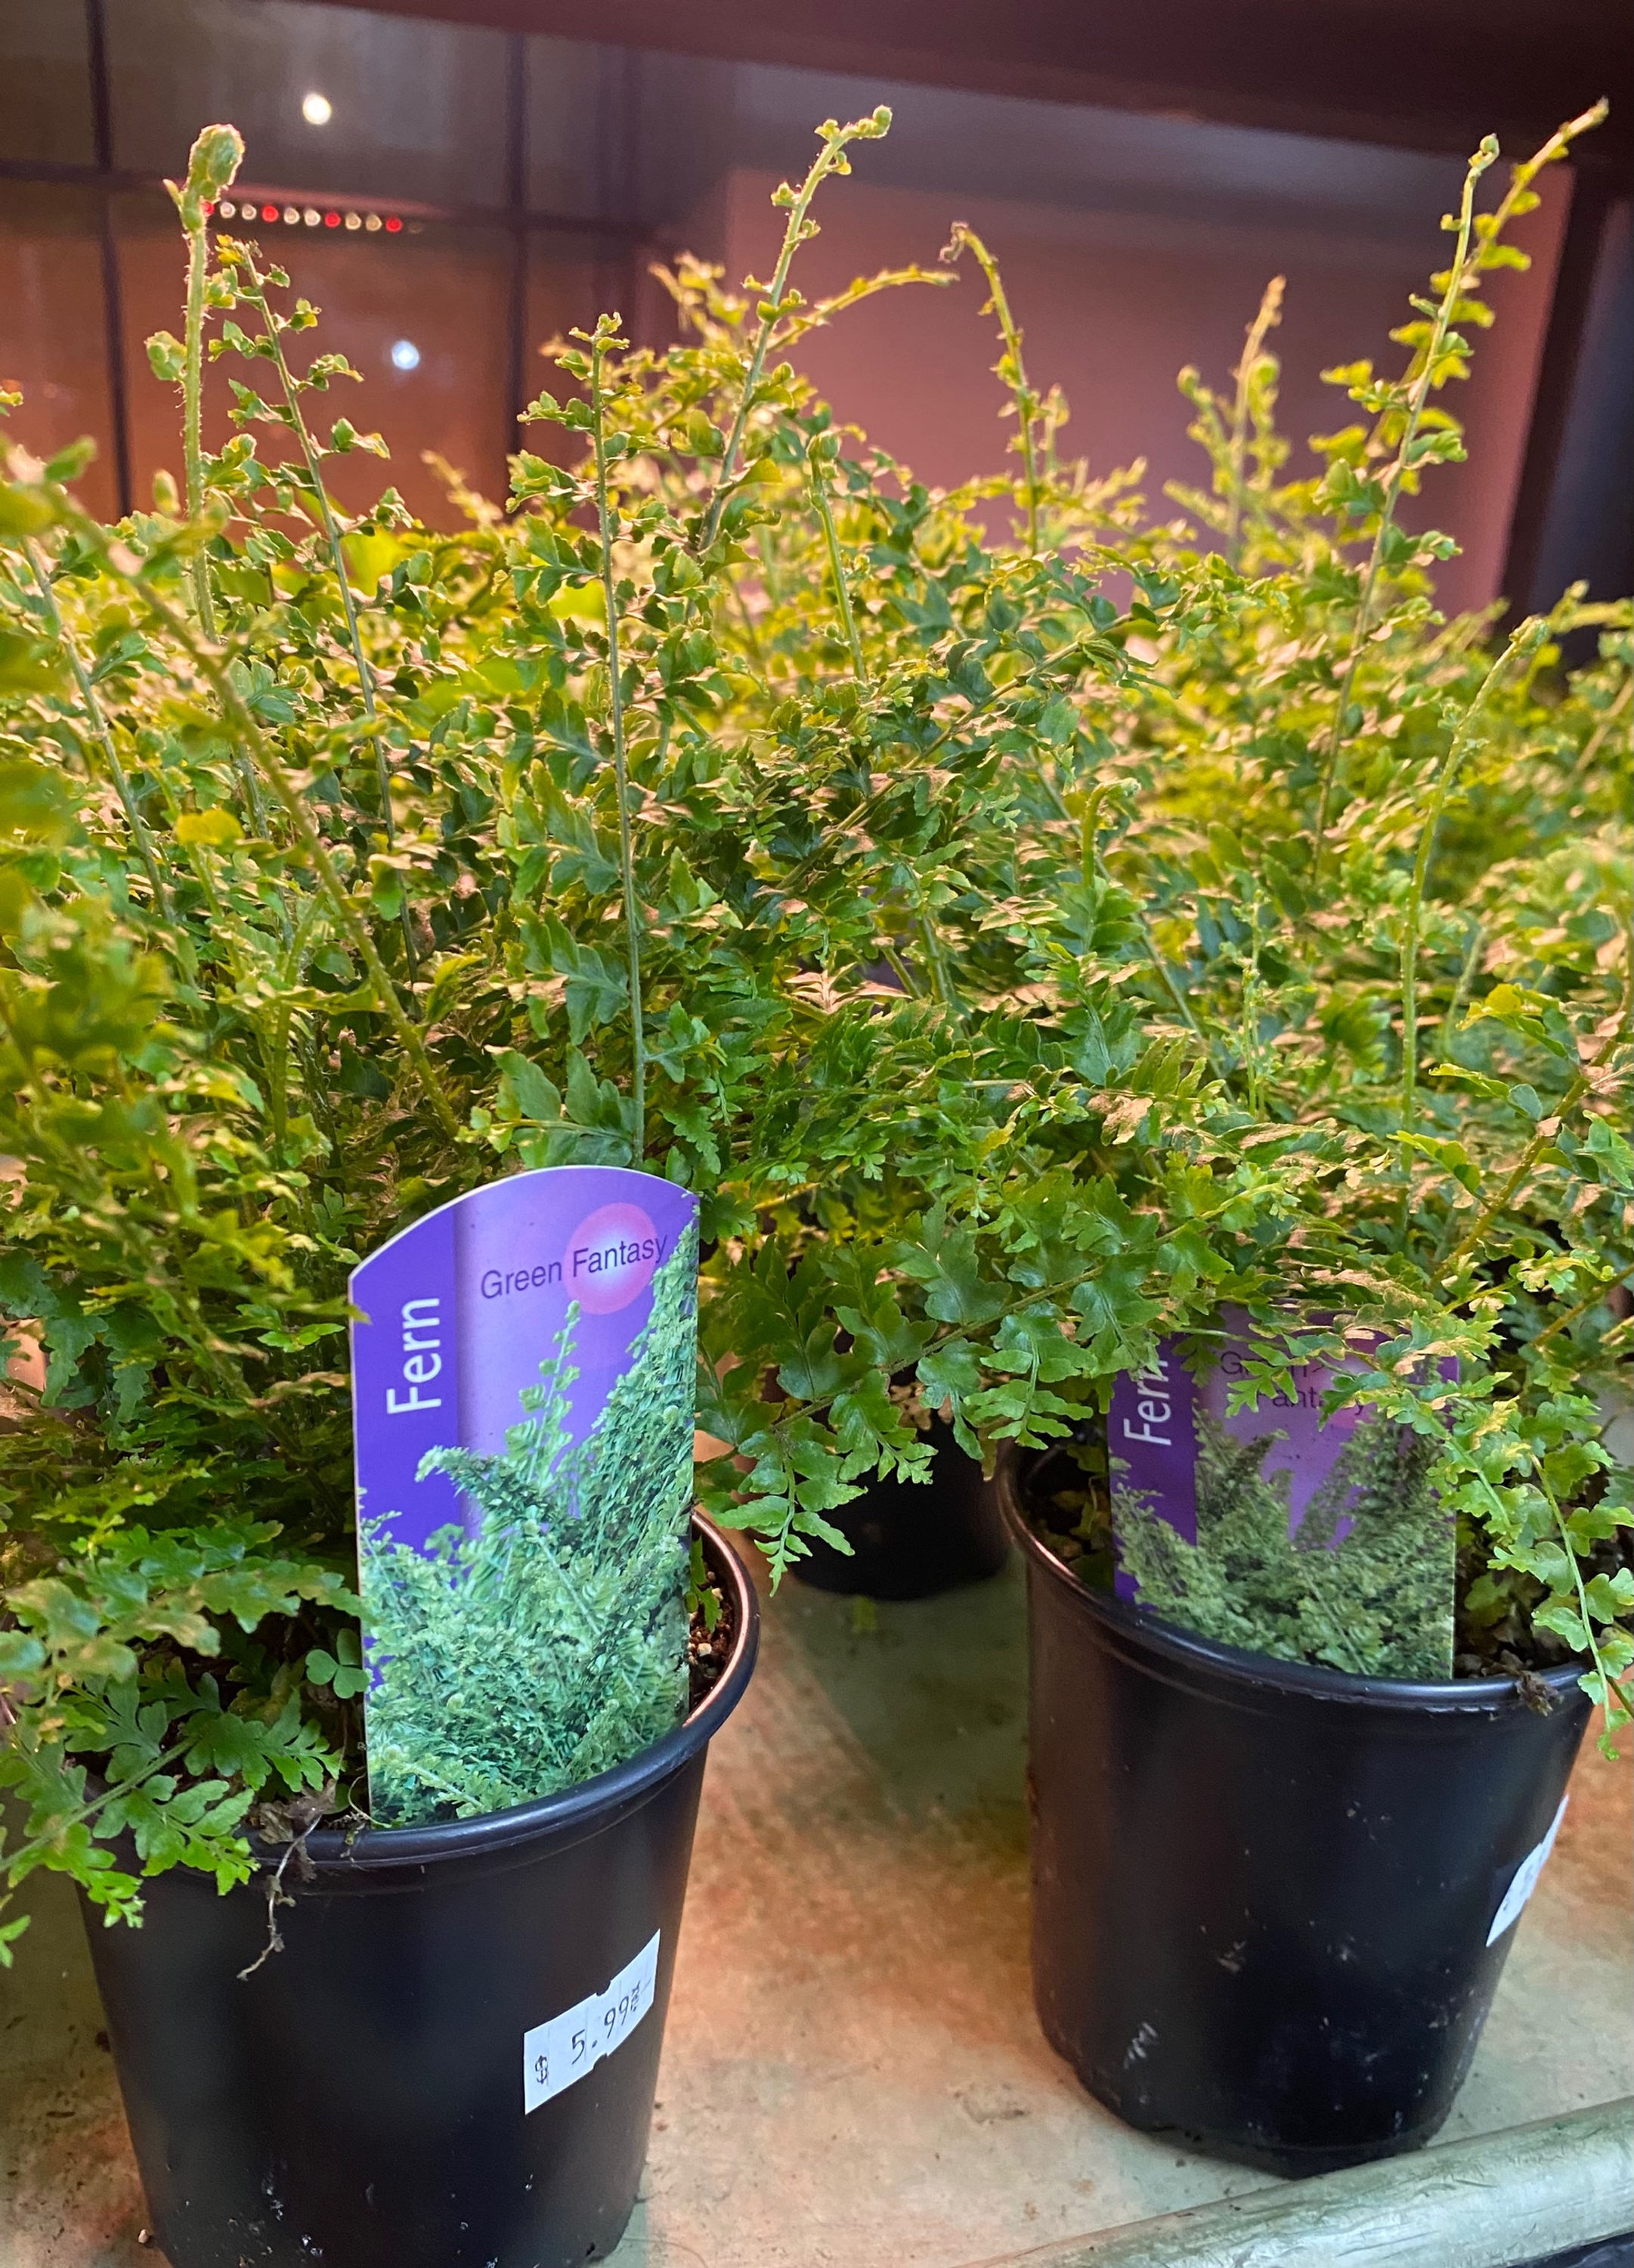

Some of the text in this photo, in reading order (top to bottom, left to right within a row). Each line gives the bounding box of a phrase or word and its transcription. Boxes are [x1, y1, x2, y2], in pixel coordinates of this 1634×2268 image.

[481, 1235, 667, 1299] Green Fantasy
[386, 1297, 442, 1414] Fern
[534, 2055, 548, 2085] $
